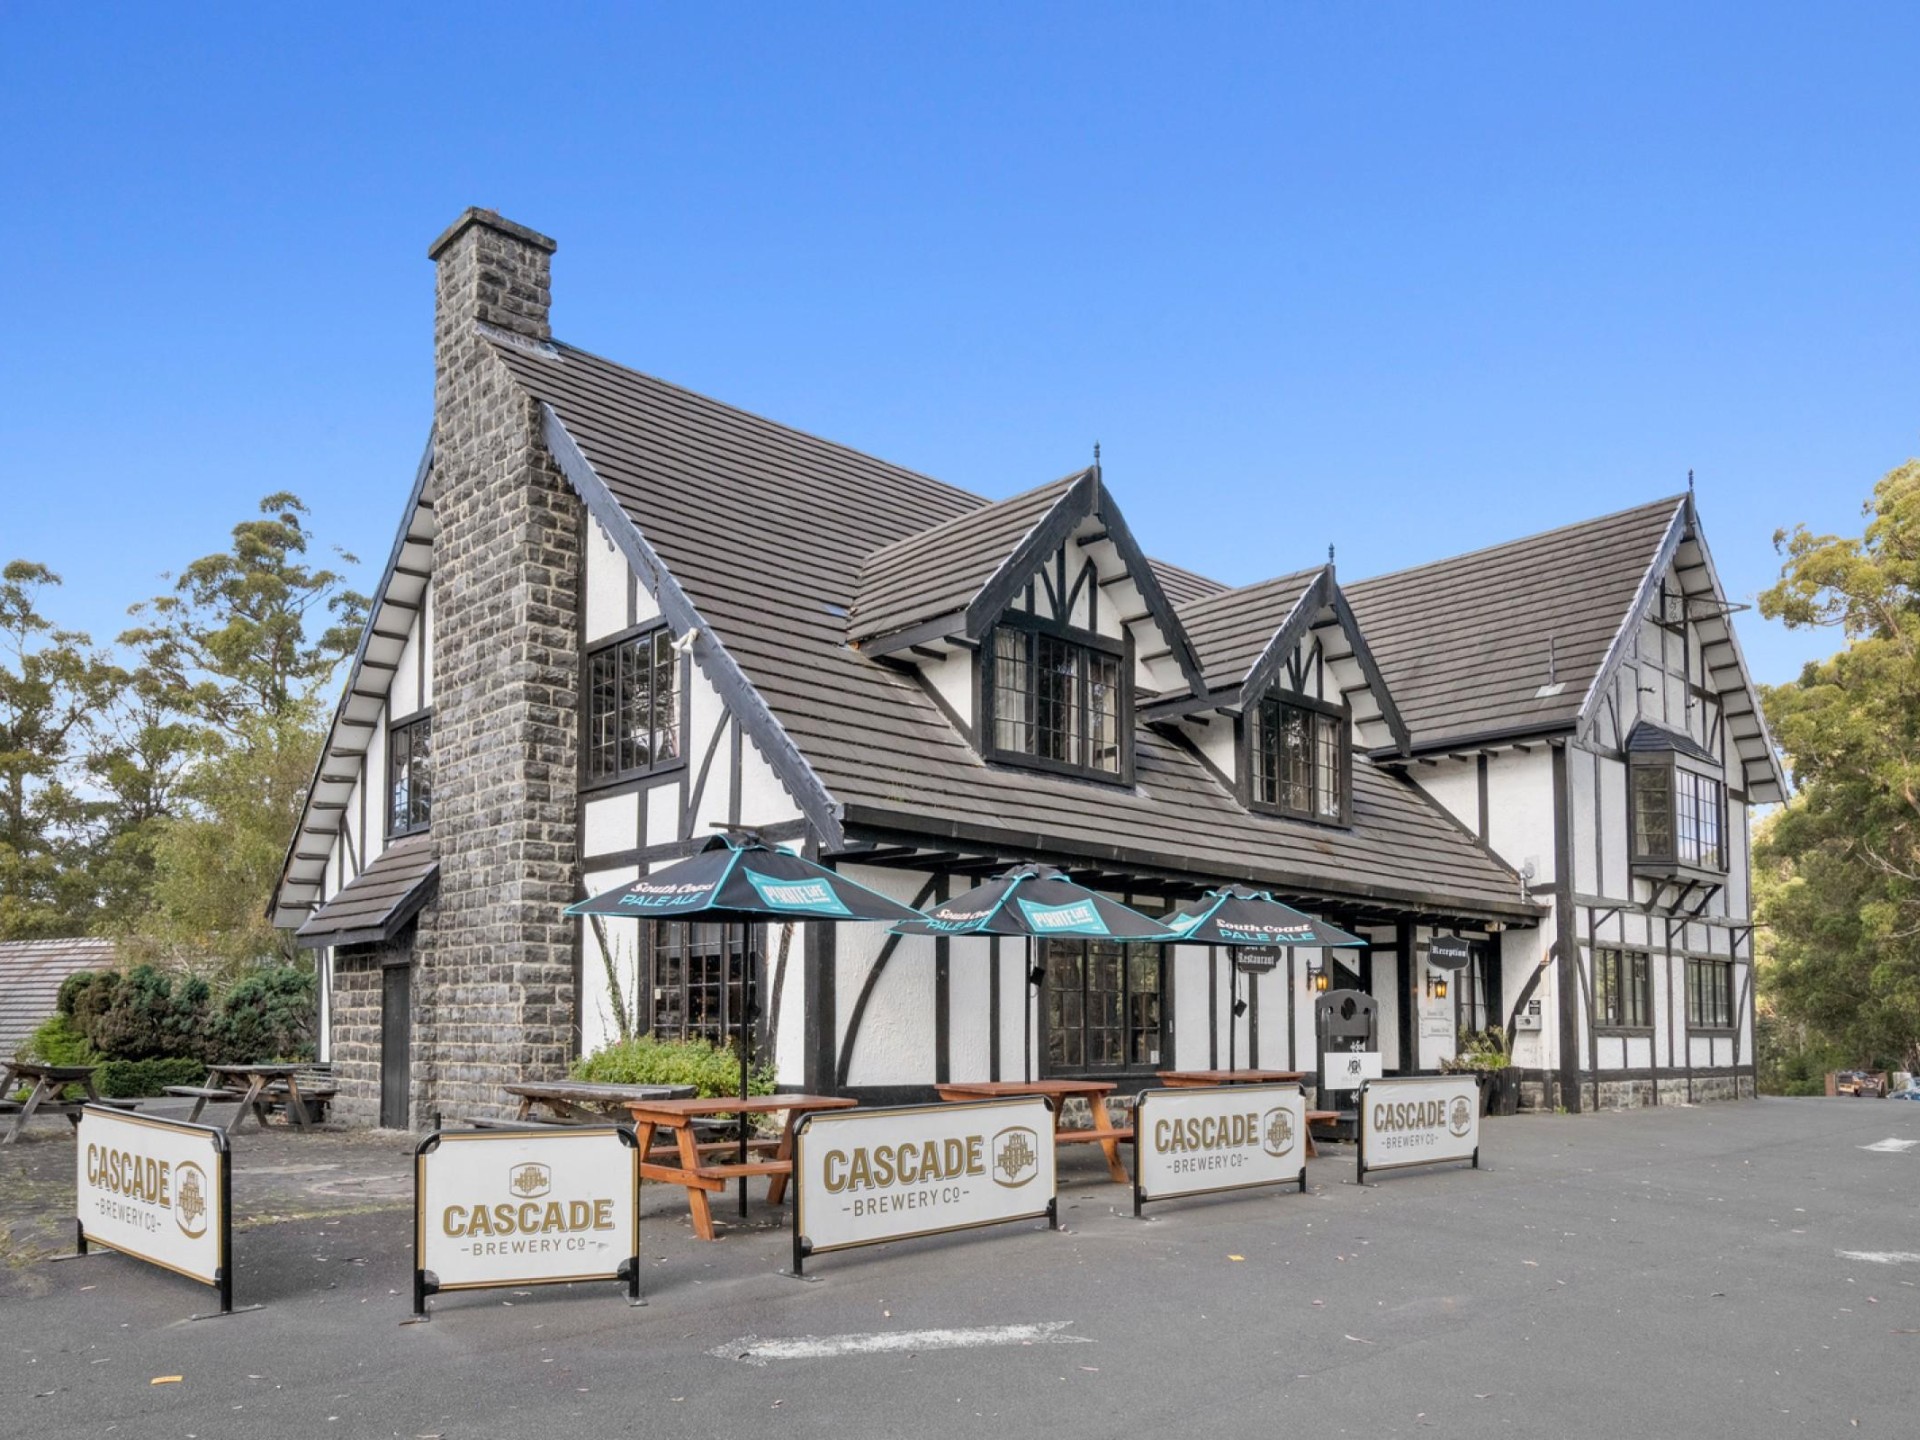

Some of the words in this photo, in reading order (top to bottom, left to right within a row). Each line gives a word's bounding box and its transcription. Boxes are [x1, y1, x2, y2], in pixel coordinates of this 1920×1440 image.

[617, 893, 671, 907] PALE
[665, 891, 705, 907] ALE
[630, 882, 678, 894] South
[1216, 918, 1261, 933] South
[1262, 923, 1312, 934] Coast
[1219, 929, 1271, 942] PALE
[1275, 932, 1317, 942] ALE
[1432, 945, 1466, 957] Reception
[1374, 1100, 1447, 1133] CASCADE
[1155, 1112, 1260, 1155] CASCADE
[87, 1142, 172, 1210] CASCADE
[823, 1135, 986, 1193] CASCADE
[442, 1199, 615, 1239] CASCADE
